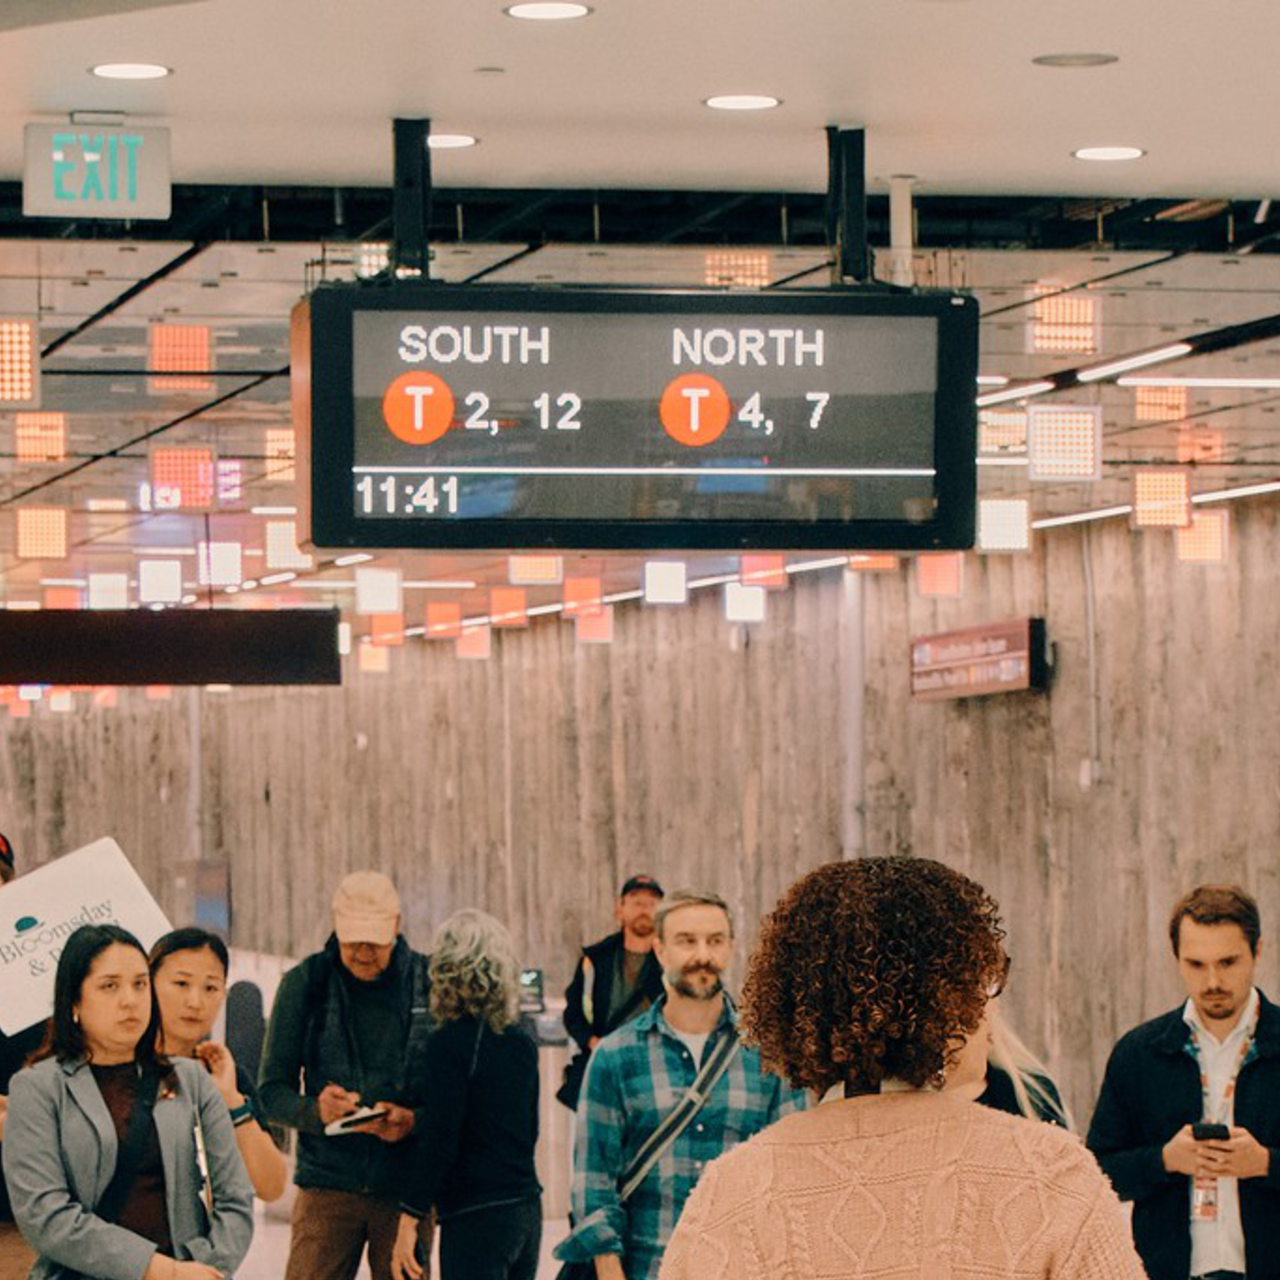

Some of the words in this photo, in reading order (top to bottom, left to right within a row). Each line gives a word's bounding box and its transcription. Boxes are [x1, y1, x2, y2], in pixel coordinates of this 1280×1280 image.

[51, 133, 144, 203] EXIT
[398, 326, 550, 364] SOUTH
[672, 328, 825, 366] NORTH
[404, 386, 434, 431] T
[464, 392, 499, 436] 2,
[532, 392, 582, 431] 12
[681, 388, 709, 432] T
[737, 392, 774, 436] 4,
[806, 393, 830, 430] 7
[356, 476, 459, 514] 11:41
